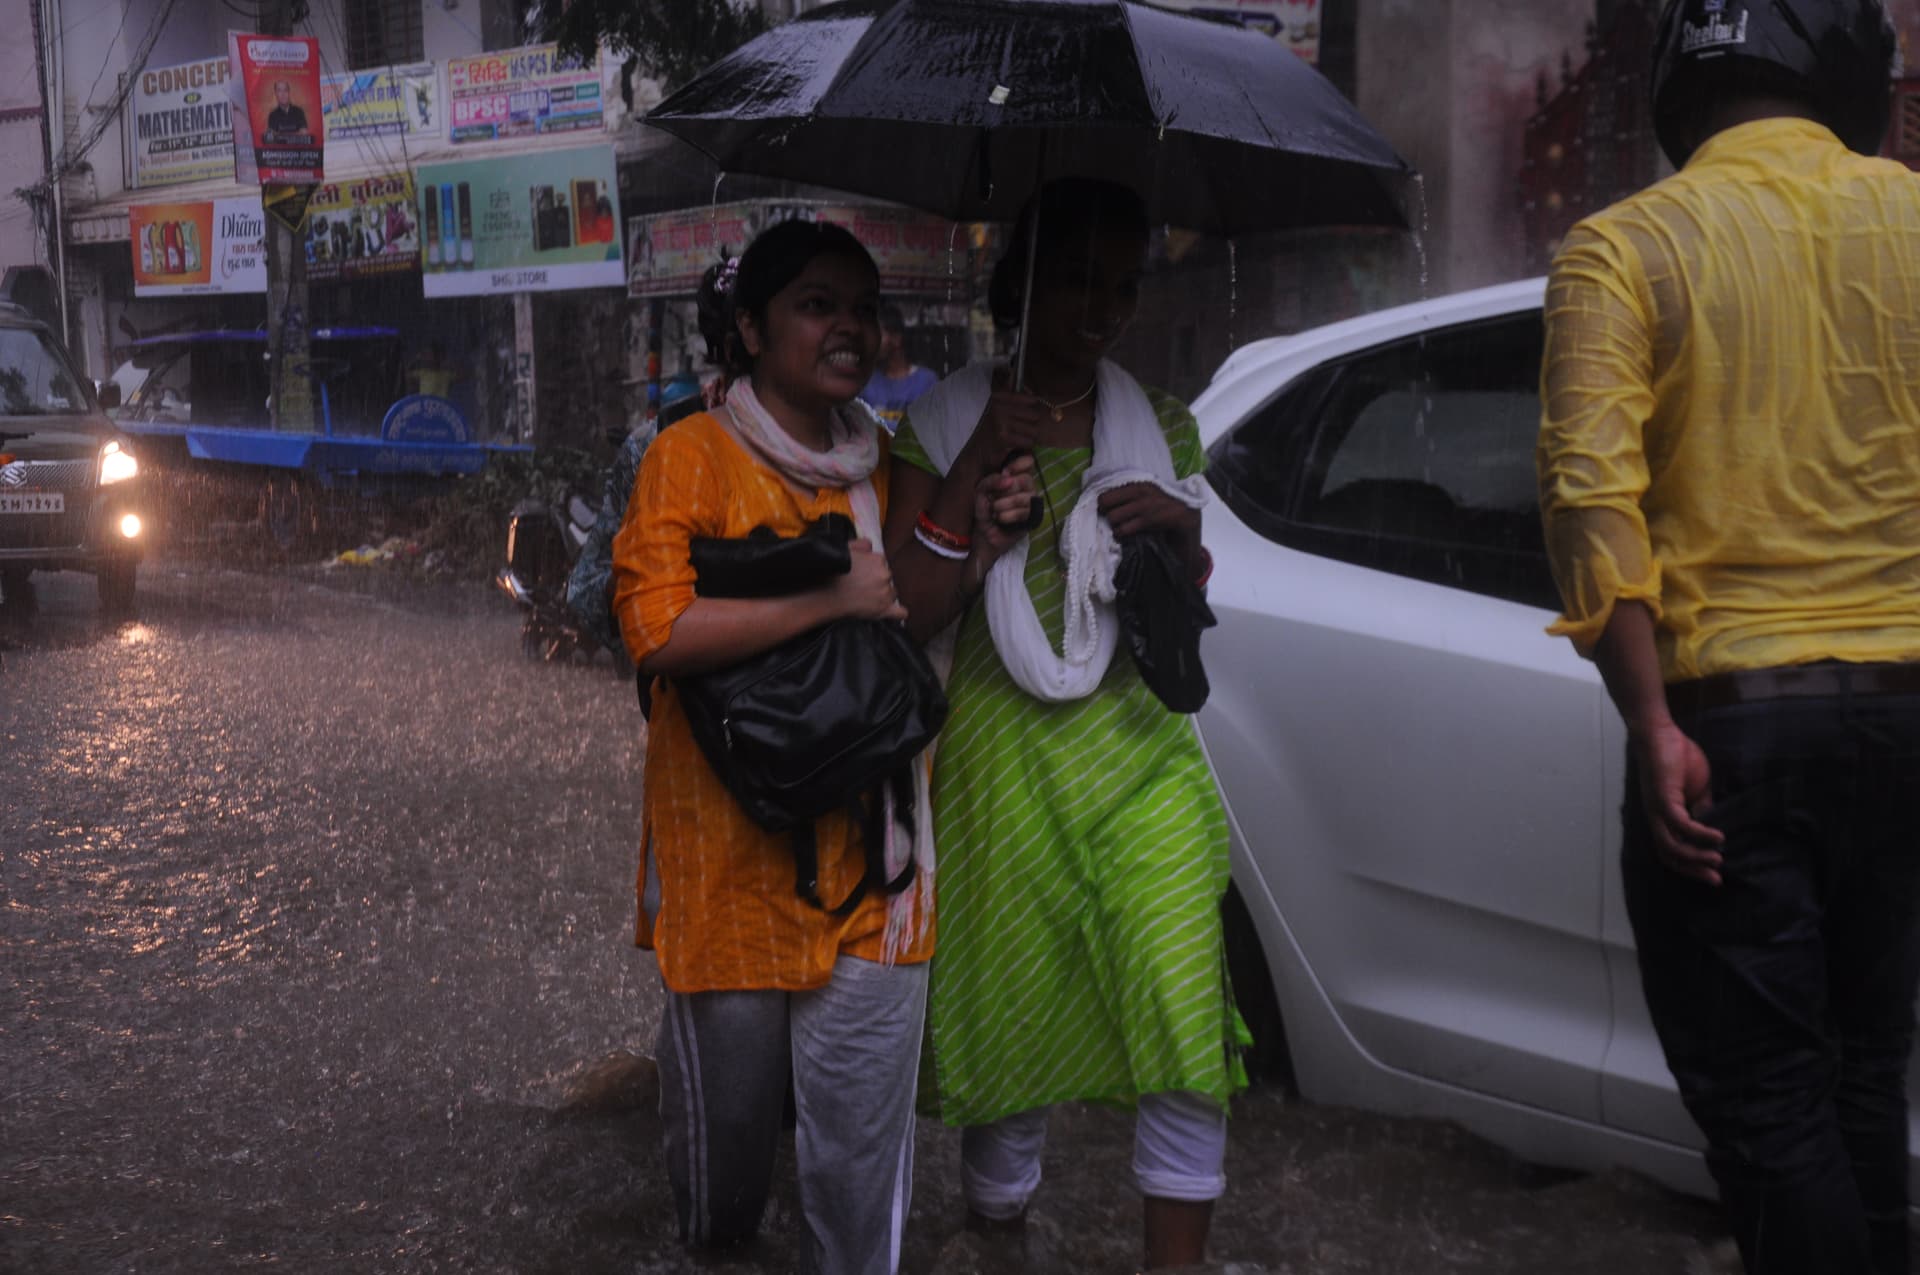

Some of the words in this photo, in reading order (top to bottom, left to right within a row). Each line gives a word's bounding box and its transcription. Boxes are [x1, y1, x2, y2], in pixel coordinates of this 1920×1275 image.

[143, 61, 230, 96] CONCEP
[138, 102, 232, 139] MATHEMATI
[455, 96, 507, 121] BPSC
[516, 270, 548, 285] STORE
